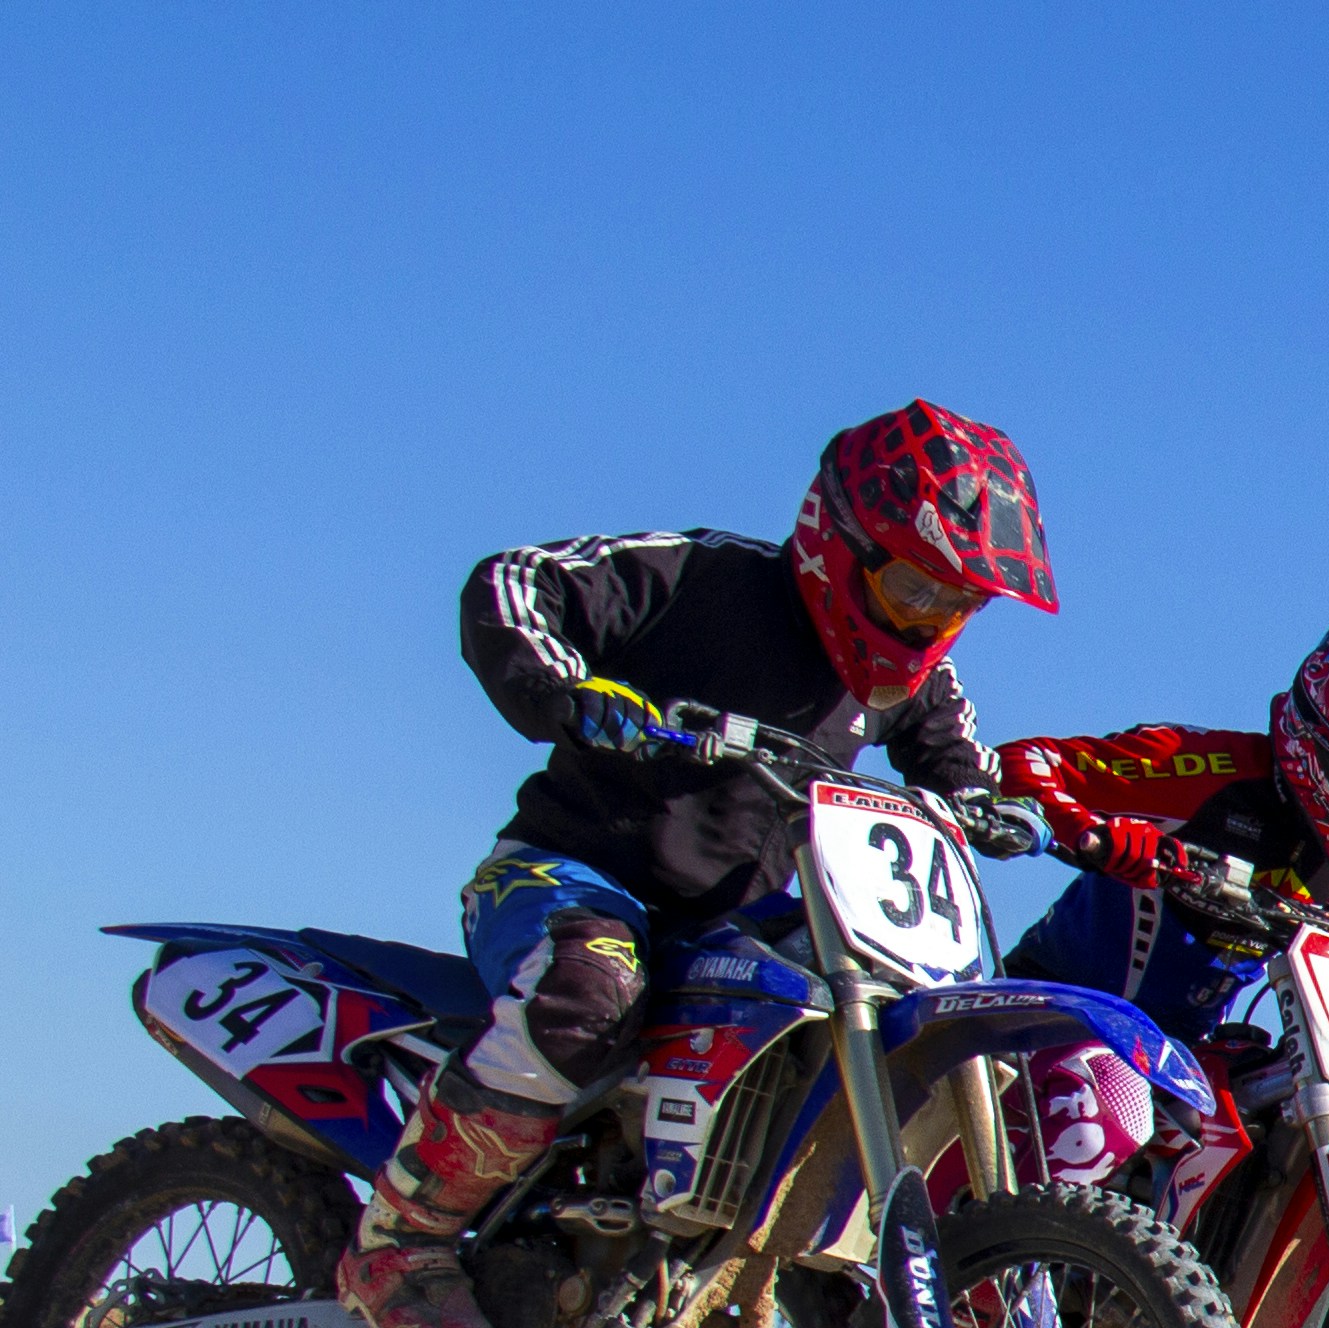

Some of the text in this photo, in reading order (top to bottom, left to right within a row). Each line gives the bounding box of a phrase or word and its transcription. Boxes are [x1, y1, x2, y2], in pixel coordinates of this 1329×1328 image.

[795, 490, 832, 584] OX
[869, 822, 962, 944] 34
[183, 960, 300, 1053] 34
[700, 956, 758, 982] YAMAHA
